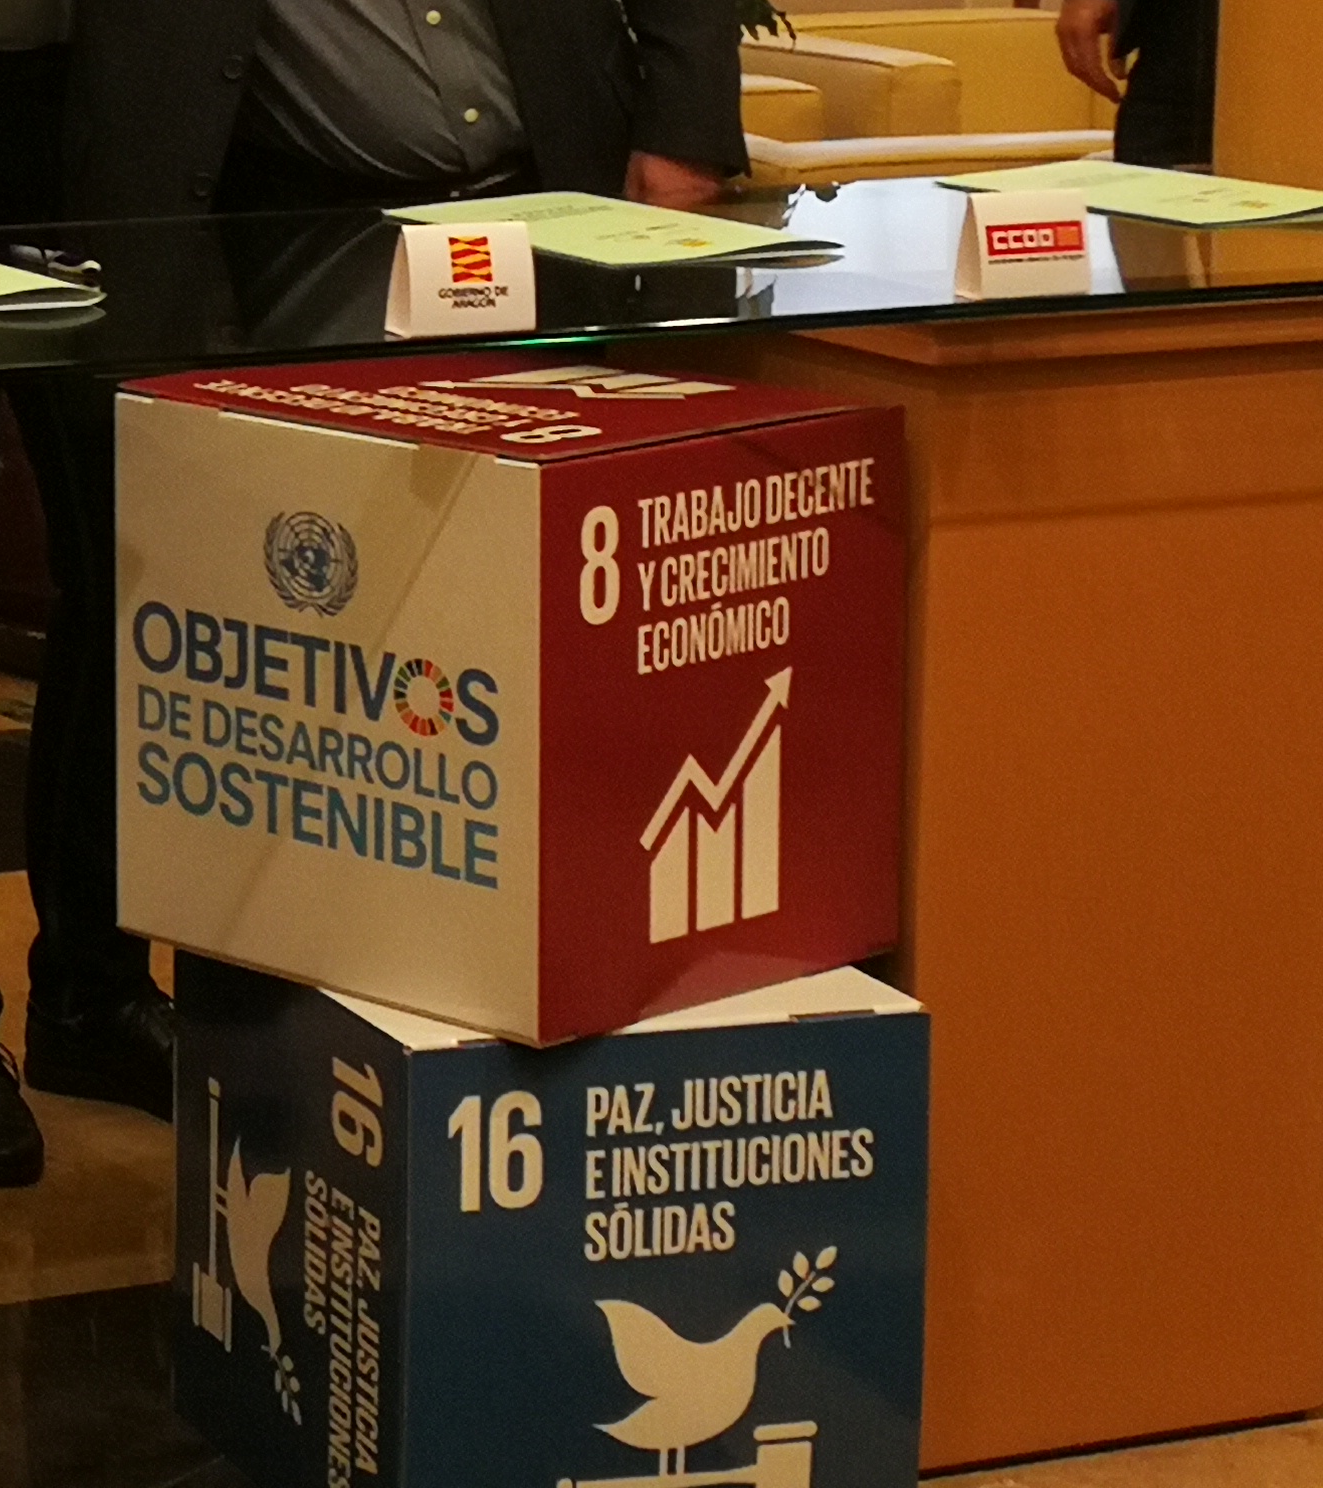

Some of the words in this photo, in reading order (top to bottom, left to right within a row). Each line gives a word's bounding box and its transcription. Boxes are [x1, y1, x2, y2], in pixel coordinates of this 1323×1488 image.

[991, 228, 1055, 250] CCOO
[638, 472, 760, 549] TRABAJO
[764, 457, 875, 523] DECENTE
[580, 505, 621, 626] 8
[638, 566, 658, 611] Y
[661, 527, 830, 609] CRECIMIENTO
[132, 600, 500, 746] OBJETIVOS
[637, 596, 790, 676] ECONÓMICO
[138, 684, 193, 742] DE
[202, 702, 498, 811] DESARROLLO
[137, 741, 499, 890] SOSTENIBLE
[330, 1055, 383, 1168] 16
[447, 1089, 543, 1214] 16
[585, 1080, 665, 1138] PAZ,
[671, 1068, 832, 1131] JUSTICIA
[331, 1186, 354, 1215] E
[585, 1151, 606, 1200] E
[612, 1127, 875, 1198] INSTITUCIONES
[302, 1170, 328, 1335] SÓLIDAS
[356, 1205, 381, 1292] PAZ,
[583, 1201, 736, 1263] SÓLIDAS
[327, 1216, 353, 1488] INSTITUCIONES
[355, 1299, 380, 1475] JUSTICIA
